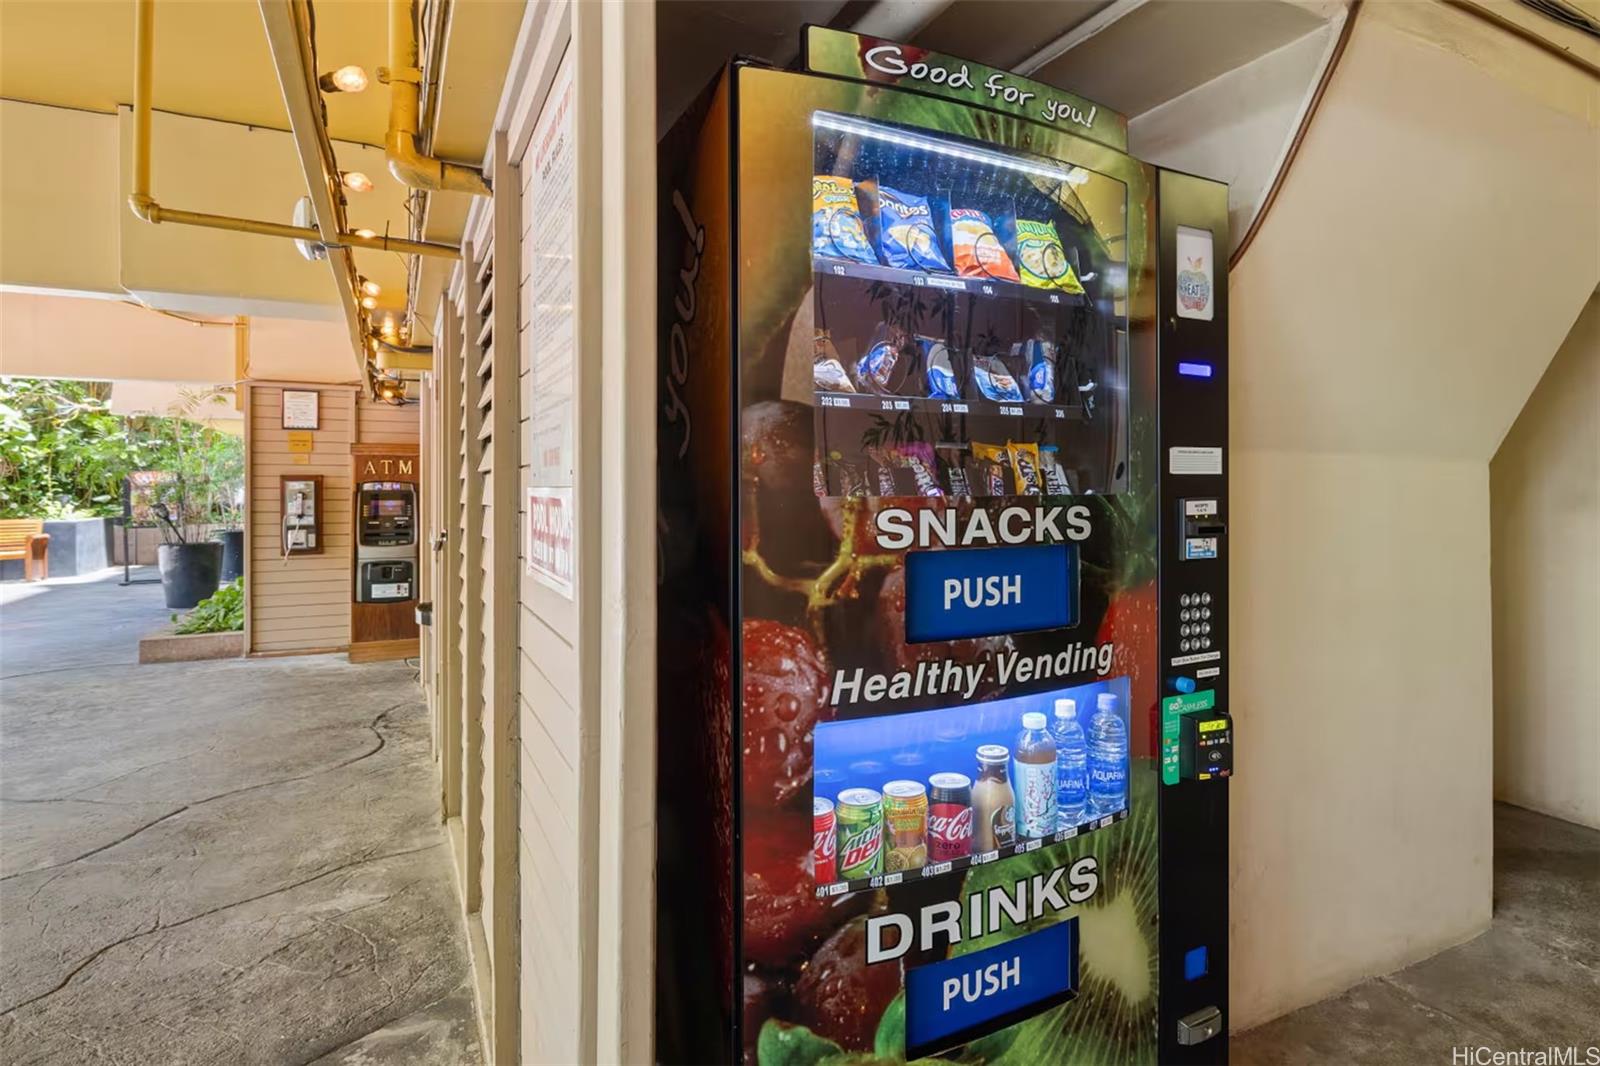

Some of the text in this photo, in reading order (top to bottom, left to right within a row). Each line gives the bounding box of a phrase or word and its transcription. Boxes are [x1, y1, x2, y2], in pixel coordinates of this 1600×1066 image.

[865, 46, 1096, 129] Good for you!
[821, 396, 833, 406] 202
[364, 460, 412, 475] ATM
[876, 505, 1092, 549] SNACKS
[943, 574, 1022, 610] PUSH
[830, 641, 1114, 706] Healthy Vending
[869, 876, 883, 888] 402
[921, 865, 934, 878] 403
[816, 886, 829, 898] 401
[866, 855, 1099, 964] DRINKS
[943, 956, 1021, 1012] PUSH
